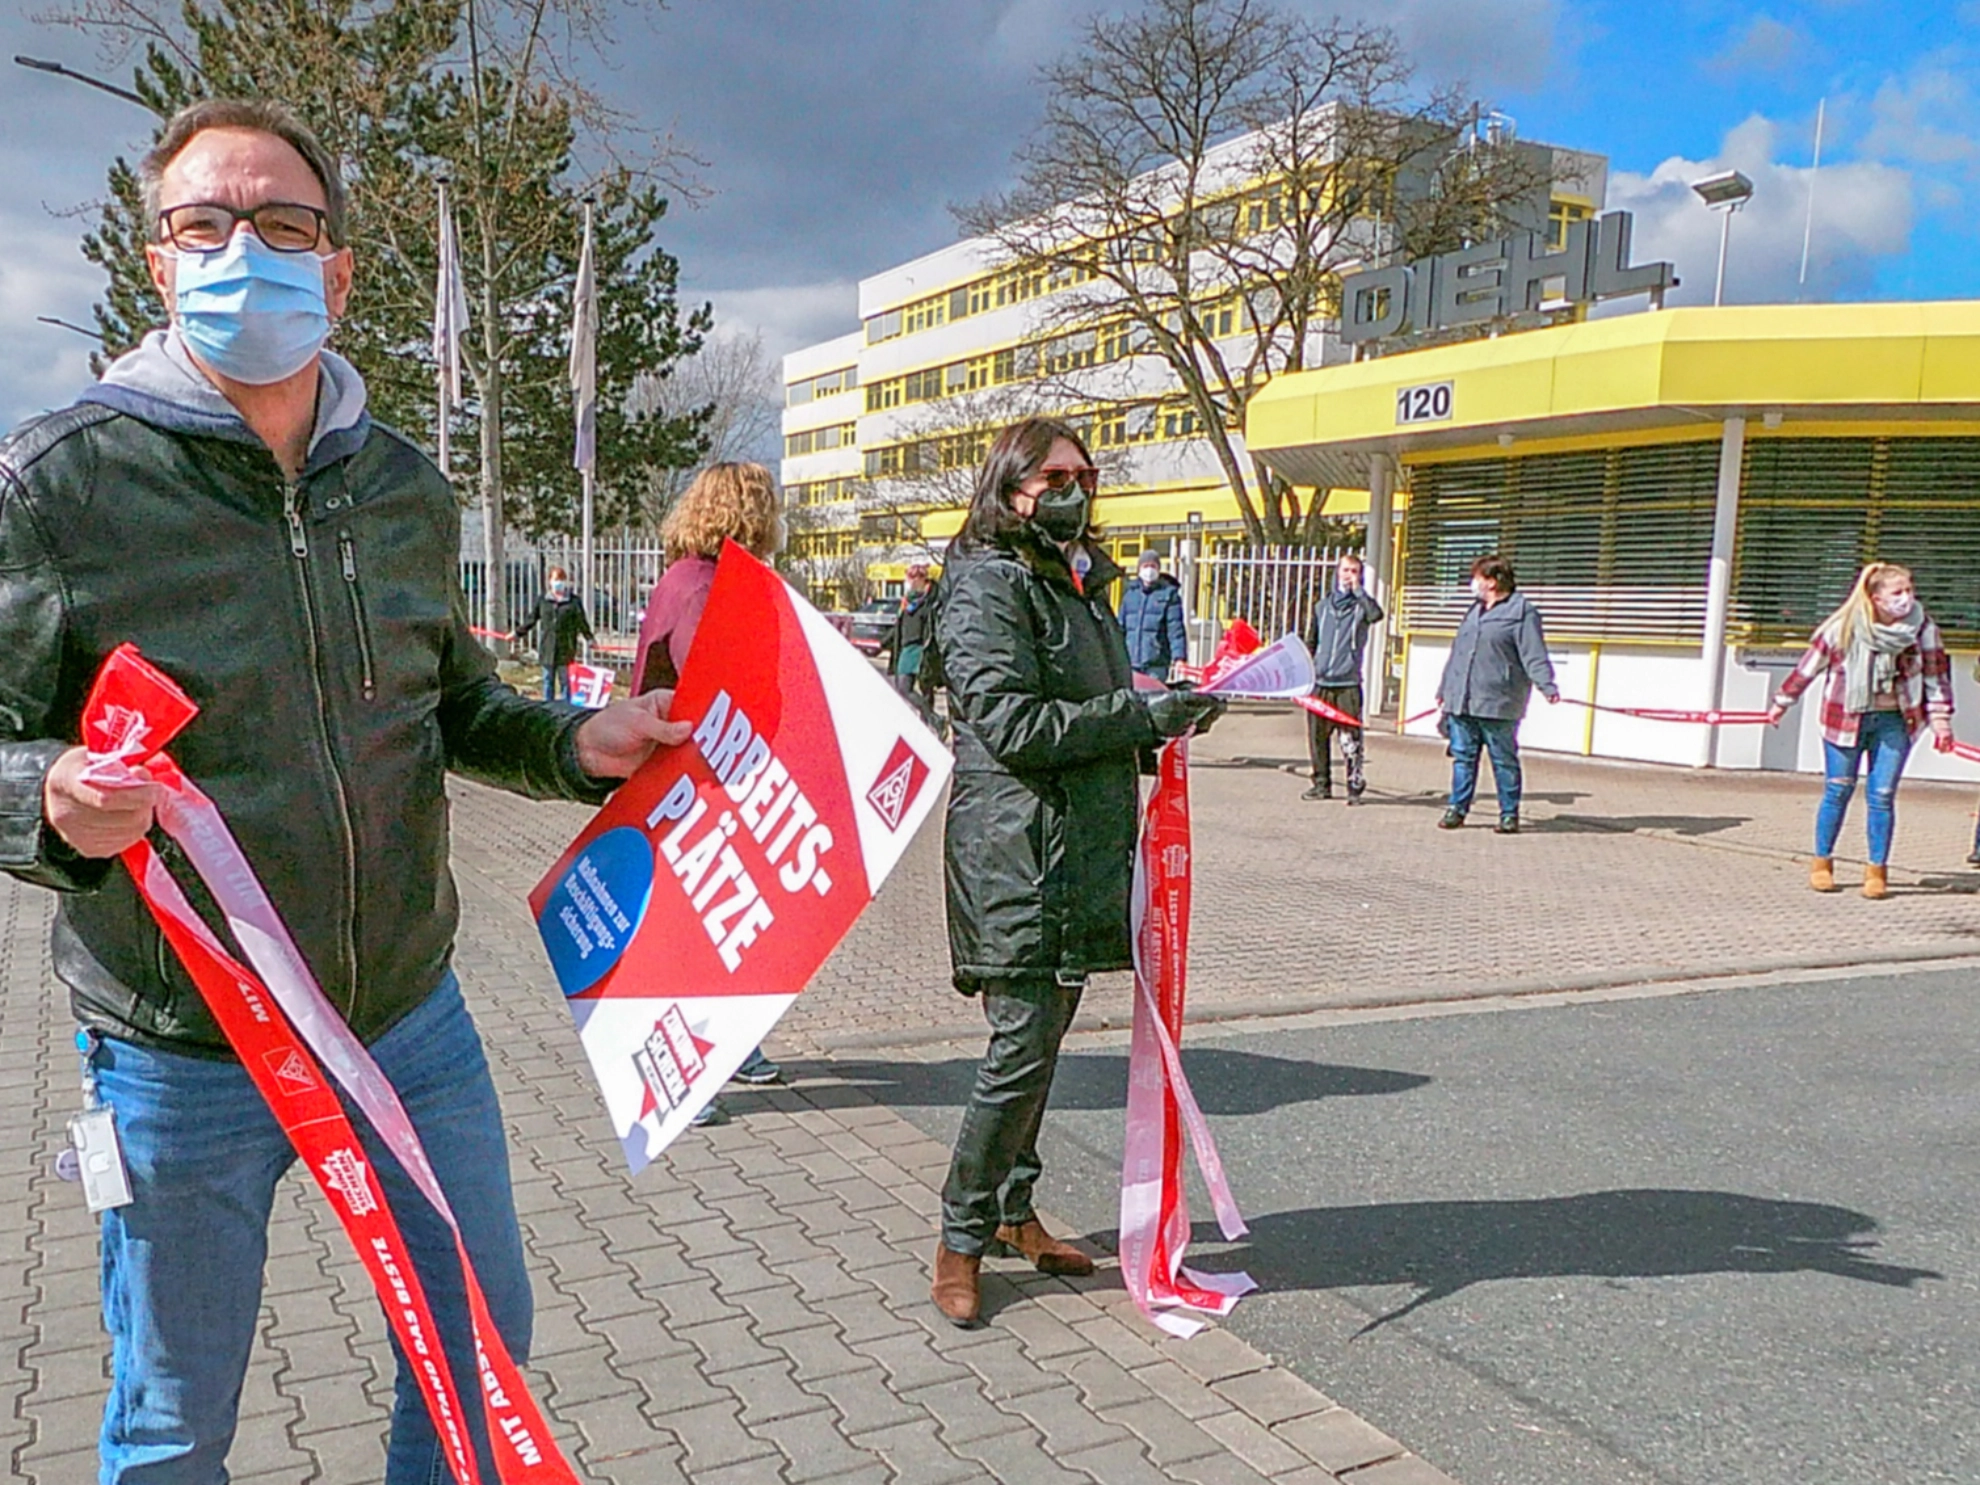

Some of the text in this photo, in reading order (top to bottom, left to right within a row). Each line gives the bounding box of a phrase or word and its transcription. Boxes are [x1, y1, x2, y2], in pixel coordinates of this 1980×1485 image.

[1341, 210, 1674, 343] DIEHL
[1397, 386, 1451, 421] 120
[692, 689, 833, 896] ARBEITS-
[565, 873, 617, 954] Beschäftigungs-
[576, 855, 631, 933] Maßnahmen zur
[646, 775, 775, 973] PLÄTZE
[559, 904, 594, 960] sicherung
[328, 1159, 361, 1213] ZUKUNFT
[370, 1235, 466, 1466] ABSTAND DAS BESTE
[498, 1414, 544, 1470] MIT
